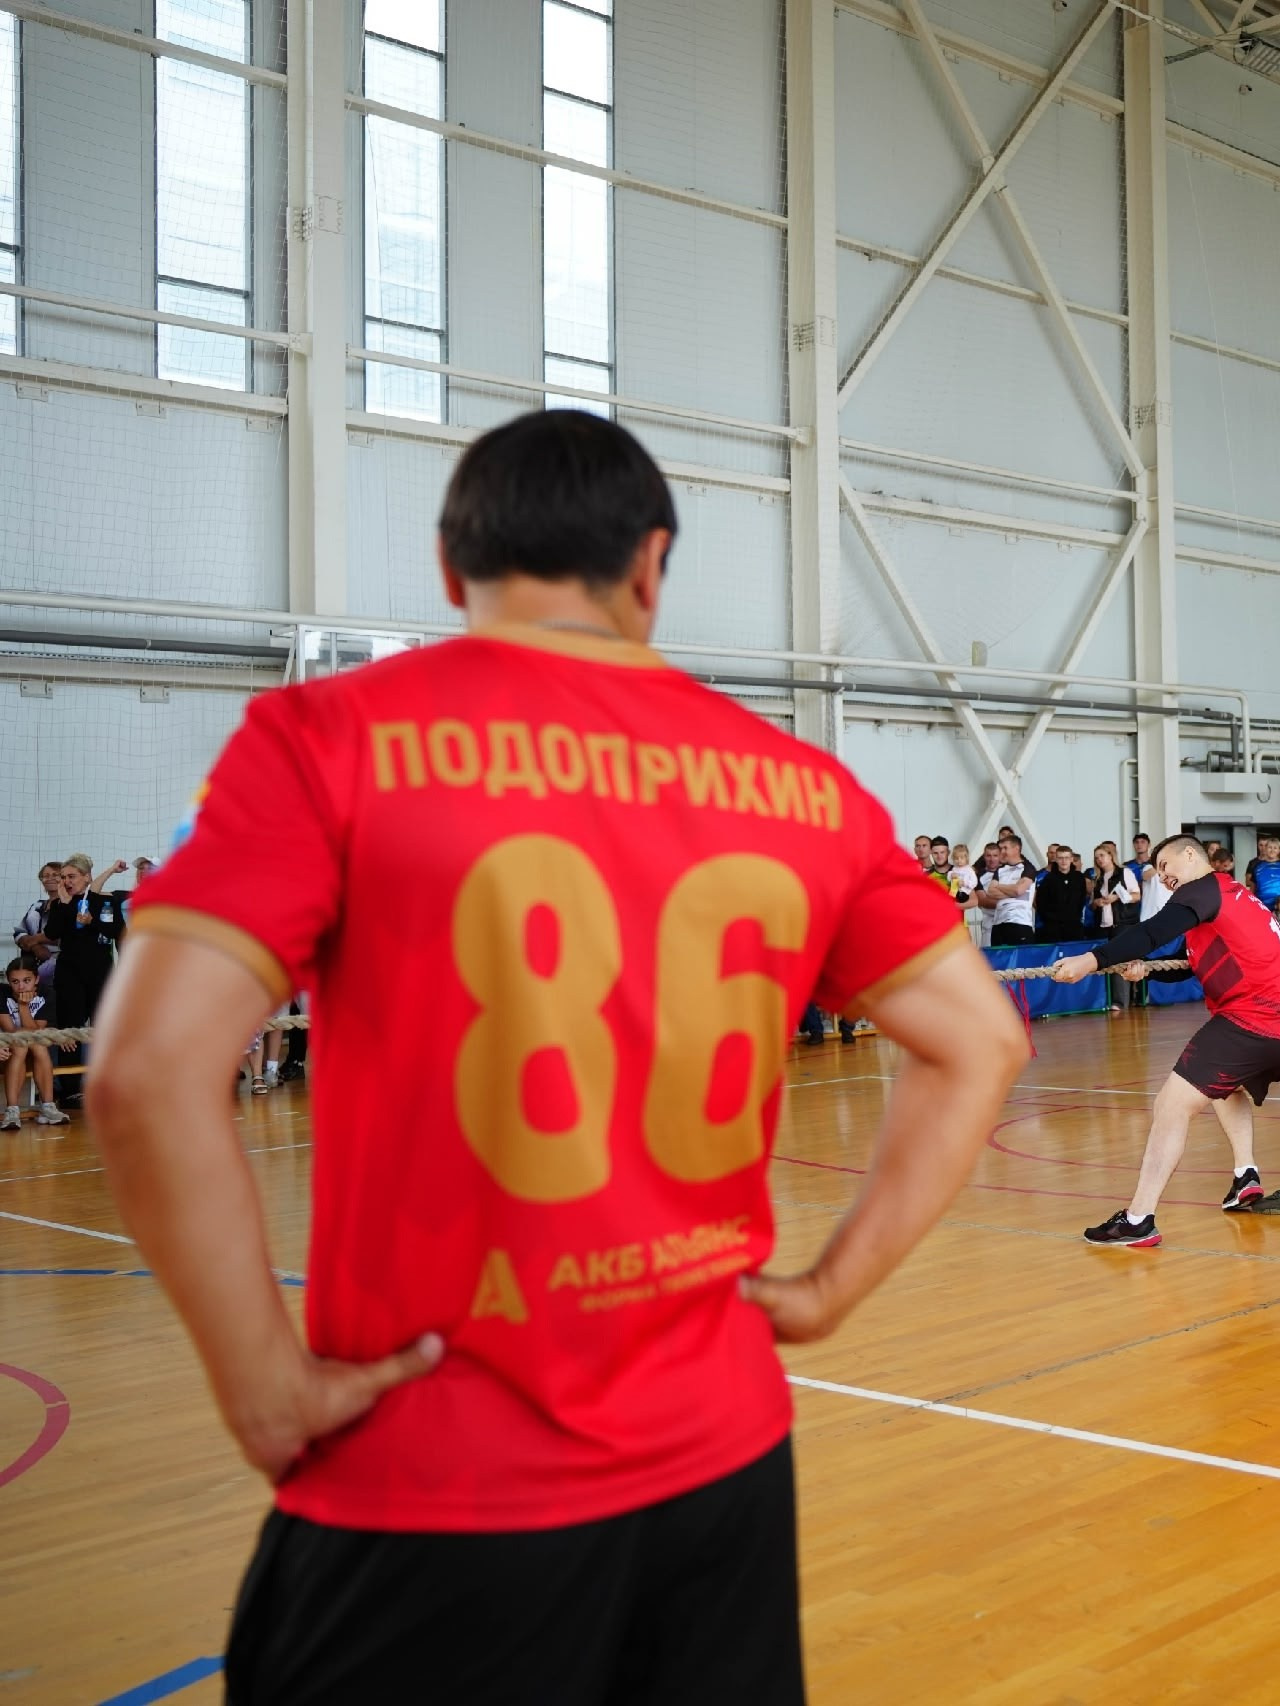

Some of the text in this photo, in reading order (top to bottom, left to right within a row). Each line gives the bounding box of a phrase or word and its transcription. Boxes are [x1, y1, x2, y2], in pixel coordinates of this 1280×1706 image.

[370, 718, 844, 831] ПОДОПРИХИН
[451, 832, 810, 1205] 86
[547, 1243, 645, 1293] АКБ
